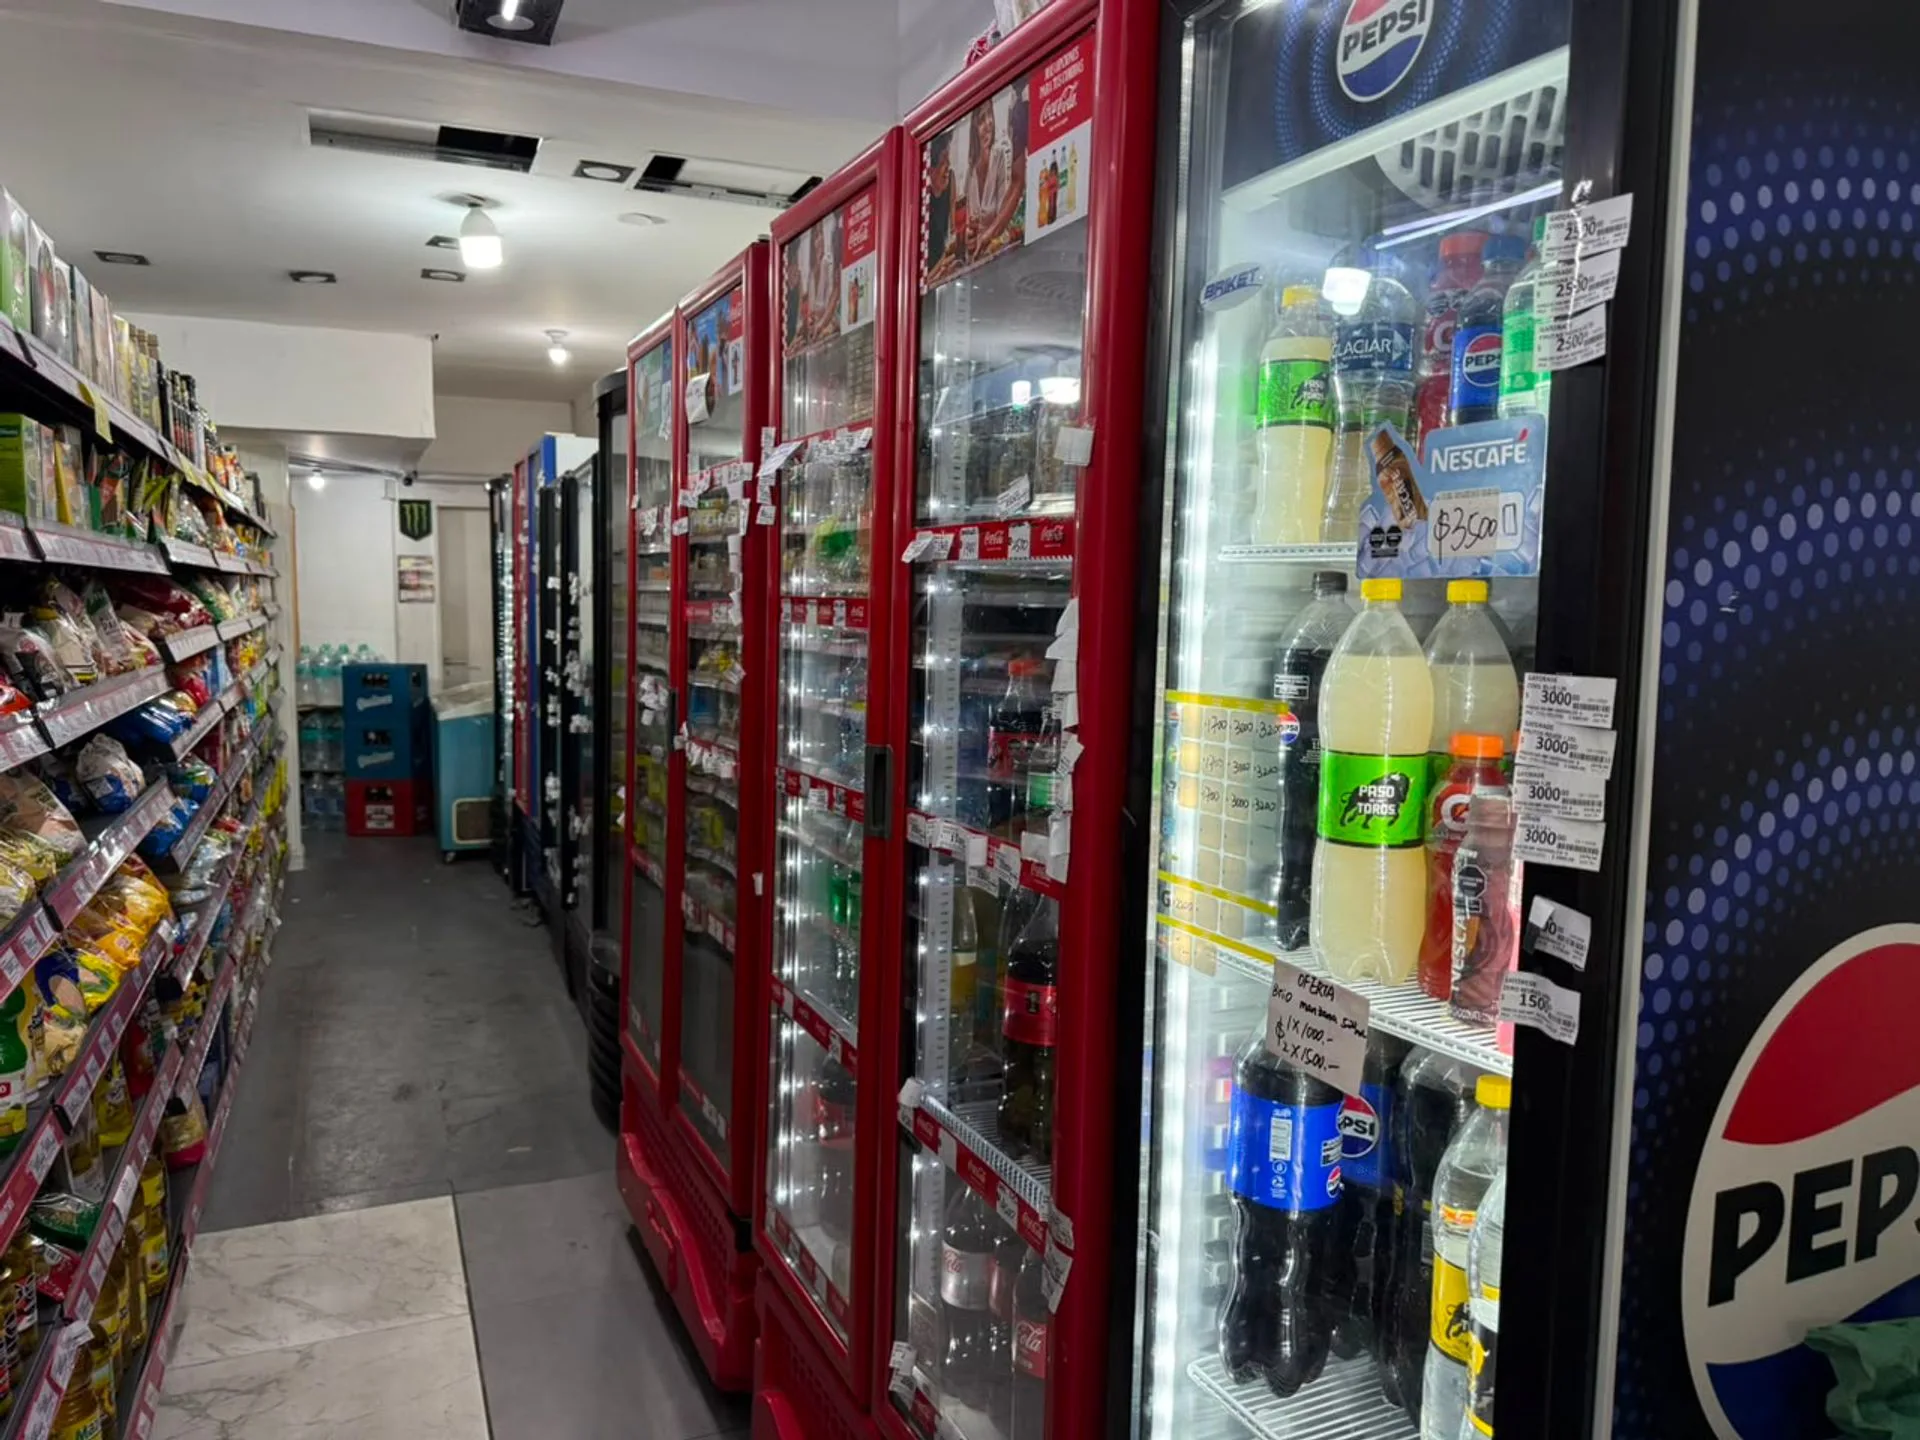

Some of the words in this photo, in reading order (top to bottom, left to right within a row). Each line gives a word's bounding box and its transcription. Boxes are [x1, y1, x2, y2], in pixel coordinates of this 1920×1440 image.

[1343, 0, 1426, 62] PEPSI
[1465, 351, 1501, 368] PEPS
[1541, 690, 1572, 706] 3000
[1536, 736, 1569, 755] 3000
[1358, 784, 1395, 799] PASO
[1529, 785, 1560, 801] 3000
[1357, 802, 1397, 816] TOROS
[1524, 829, 1557, 846] 3000
[1298, 973, 1335, 1002] OFERTA
[1340, 1117, 1375, 1136] PSI
[1707, 1145, 1920, 1308] PEP
